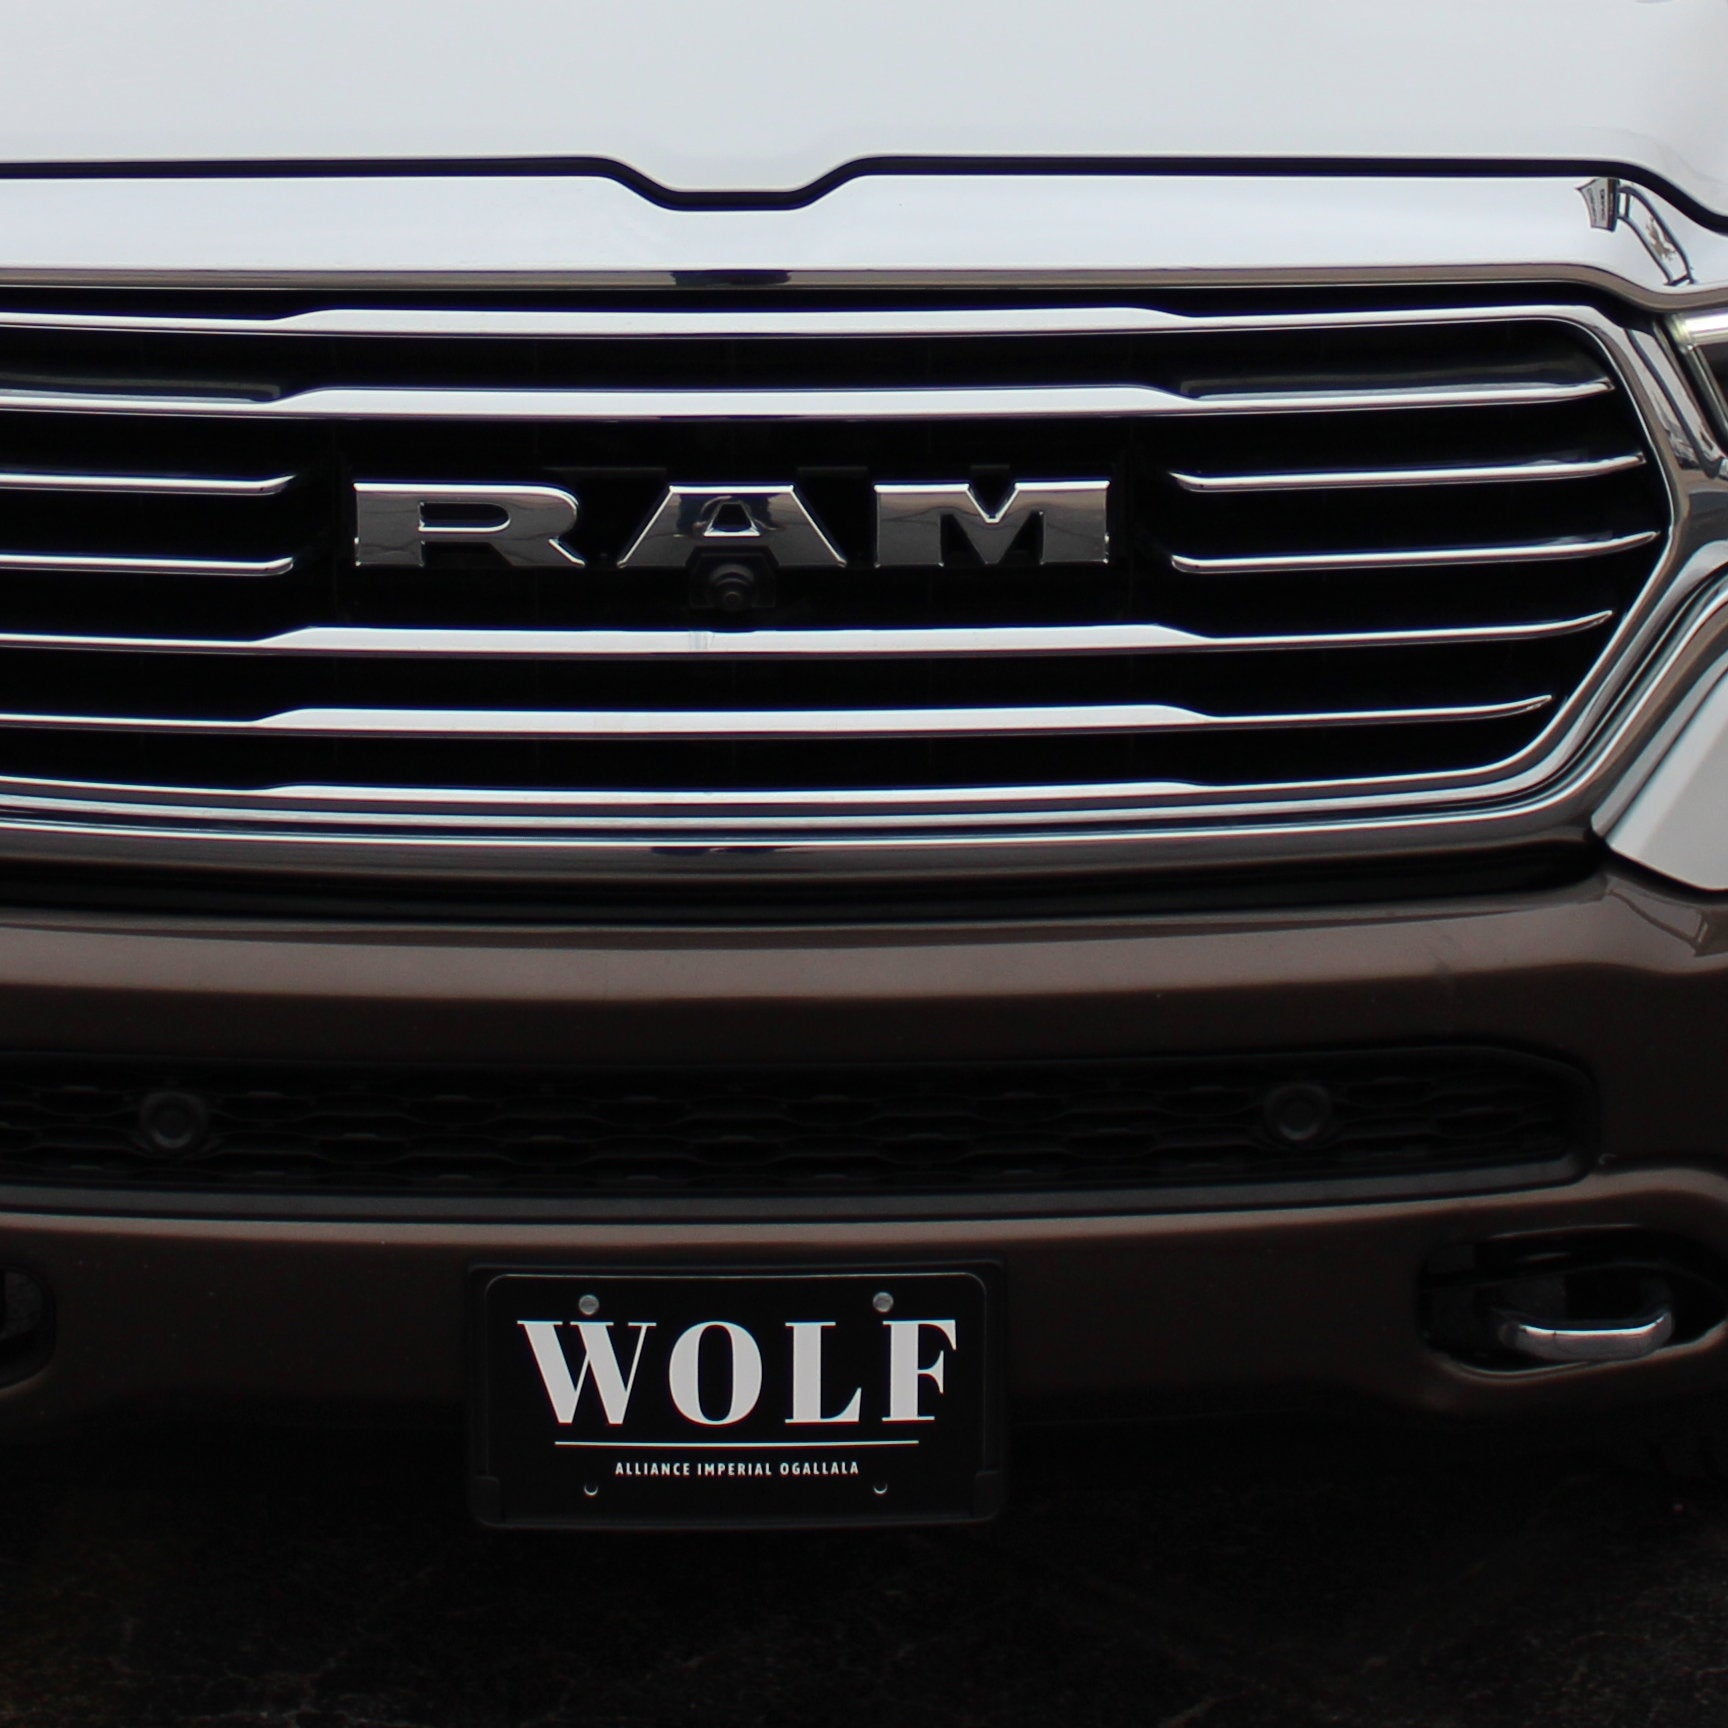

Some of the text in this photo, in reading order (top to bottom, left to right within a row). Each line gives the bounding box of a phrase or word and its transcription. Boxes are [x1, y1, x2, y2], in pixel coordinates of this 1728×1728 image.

[353, 479, 1111, 569] RAM
[516, 1319, 958, 1426] WOLF
[615, 1461, 860, 1476] ALLIANCE IMPERIAL OGALLALA
